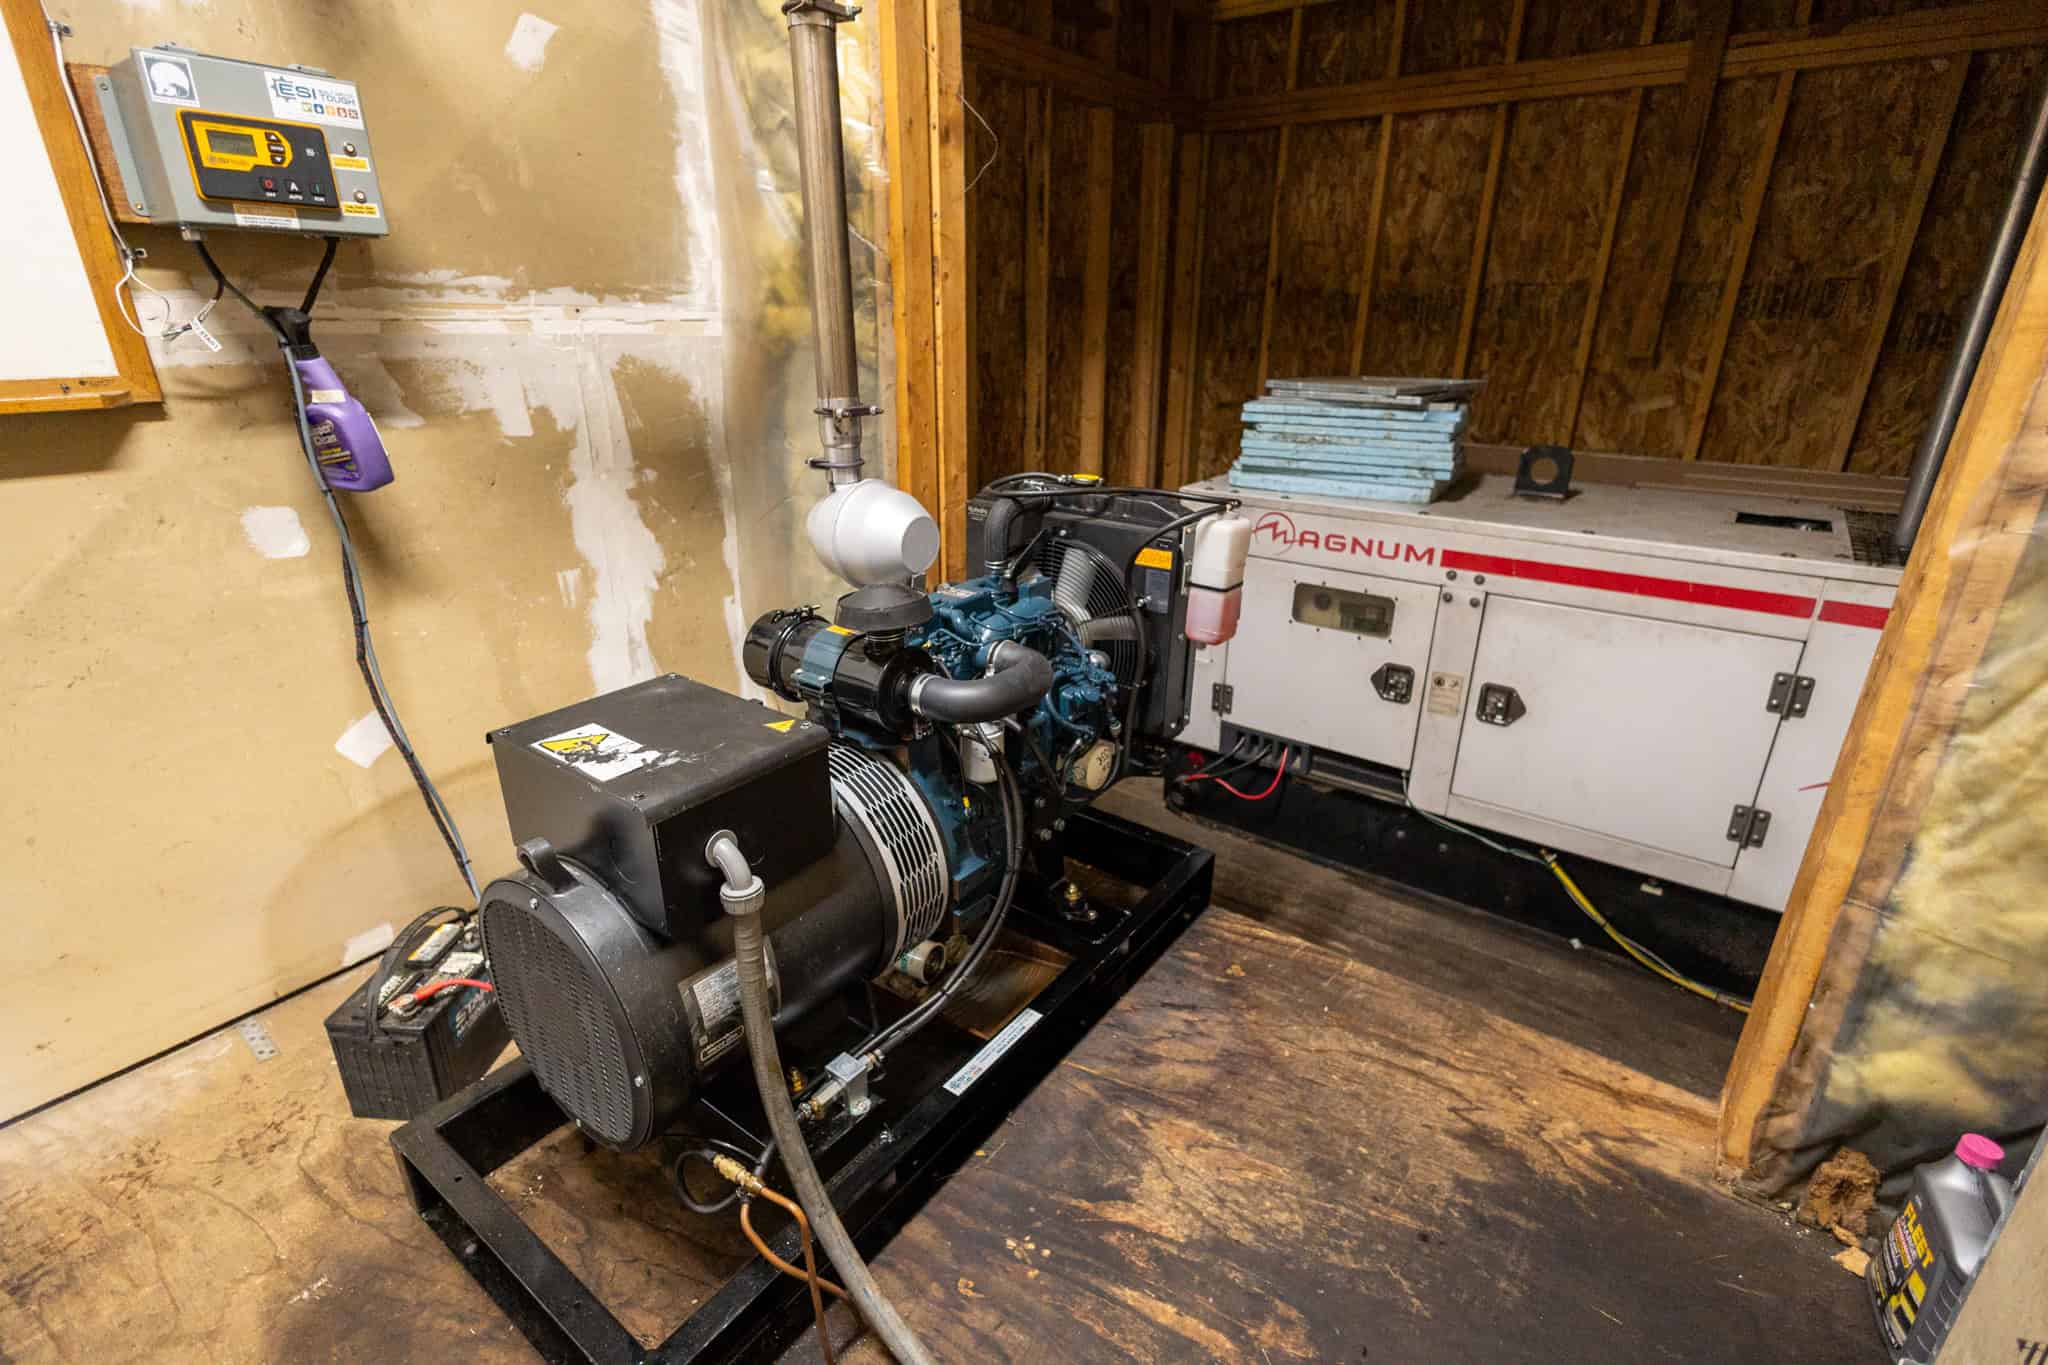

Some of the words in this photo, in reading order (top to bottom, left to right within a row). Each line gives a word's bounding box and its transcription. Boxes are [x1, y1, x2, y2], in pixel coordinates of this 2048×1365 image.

[279, 82, 317, 100] ESI
[1252, 512, 1437, 567] MAGNUM
[1903, 1199, 1935, 1269] FLEET
